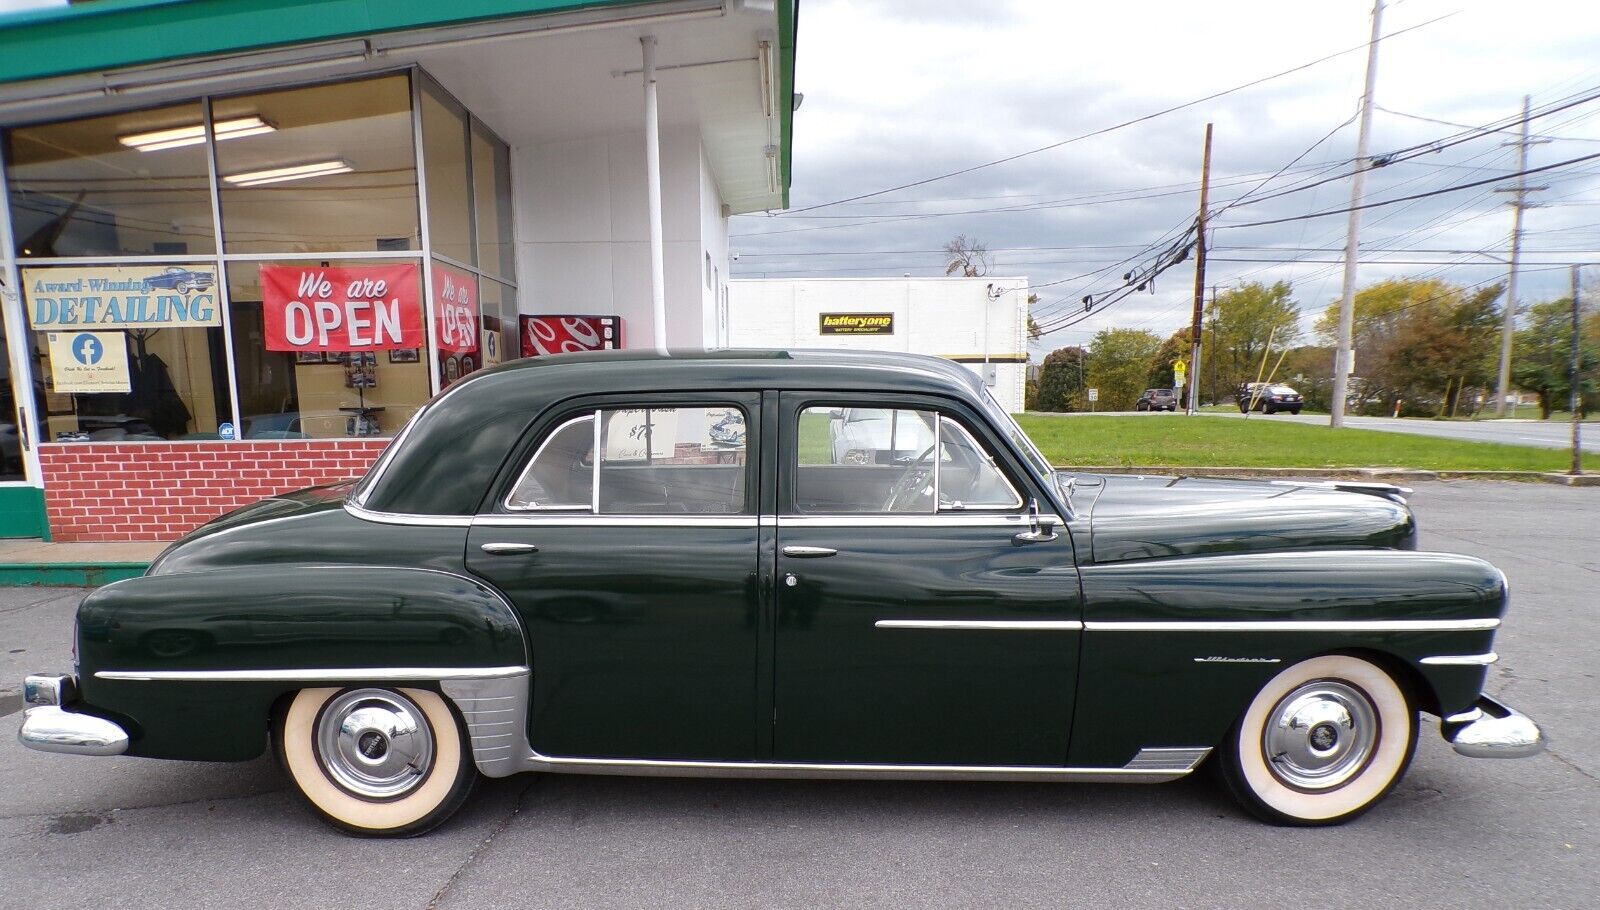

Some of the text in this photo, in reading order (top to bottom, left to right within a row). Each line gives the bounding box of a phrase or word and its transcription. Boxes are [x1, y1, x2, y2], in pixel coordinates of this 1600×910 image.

[34, 278, 150, 295] Award-Winning
[298, 271, 388, 299] We are
[34, 294, 214, 325] DETAILING
[285, 297, 402, 346] OPEN
